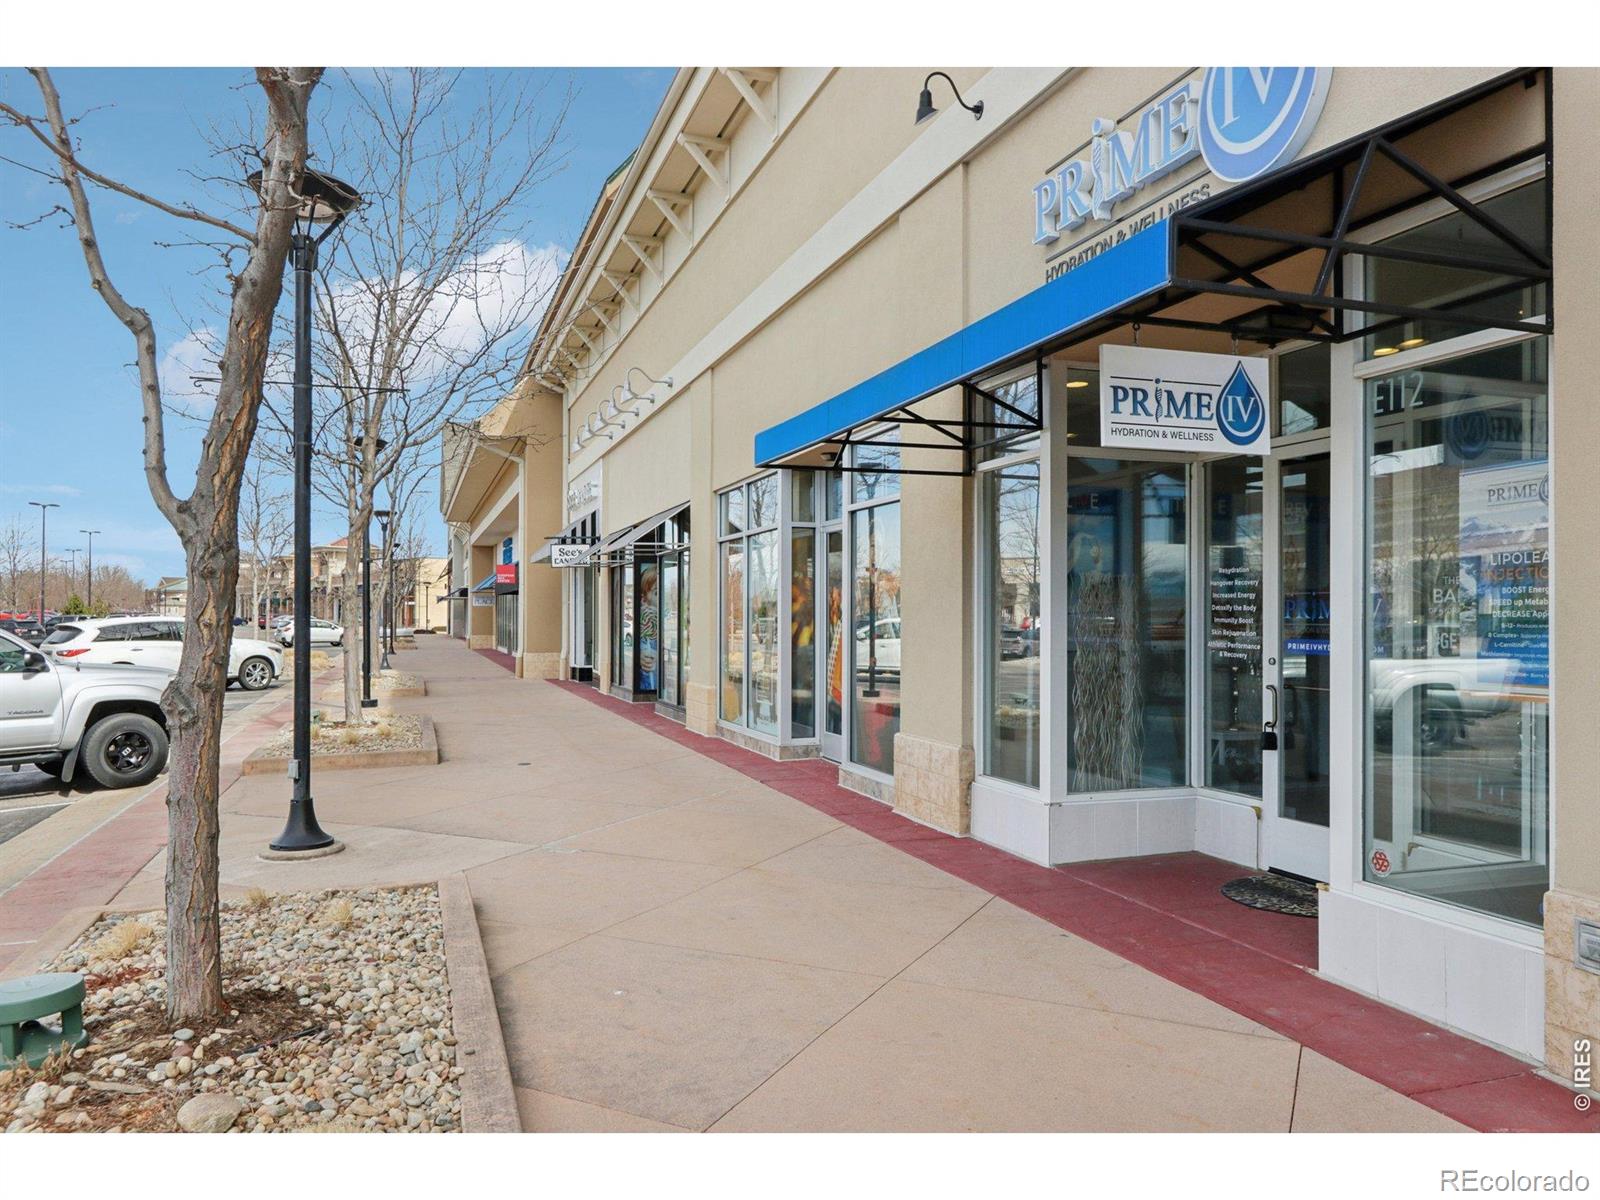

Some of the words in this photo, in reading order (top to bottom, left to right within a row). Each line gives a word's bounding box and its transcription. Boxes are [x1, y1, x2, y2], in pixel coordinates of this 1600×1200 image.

[1032, 82, 1200, 245] PRIME
[1045, 236, 1113, 284] HYDRATION
[1374, 372, 1424, 413] E112
[1109, 378, 1215, 422] PRIME
[1226, 395, 1258, 423] IV
[1111, 427, 1159, 439] HYDRATION
[1161, 430, 1168, 439] &
[1170, 431, 1214, 442] WELLNESS
[1488, 482, 1538, 502] PRIME
[1234, 579, 1259, 587] Recovery
[1237, 592, 1256, 600] Energy
[1211, 604, 1233, 612] Detoxify
[1242, 604, 1257, 612] Body
[1227, 642, 1261, 650] Performance
[1223, 651, 1248, 660] Recovery
